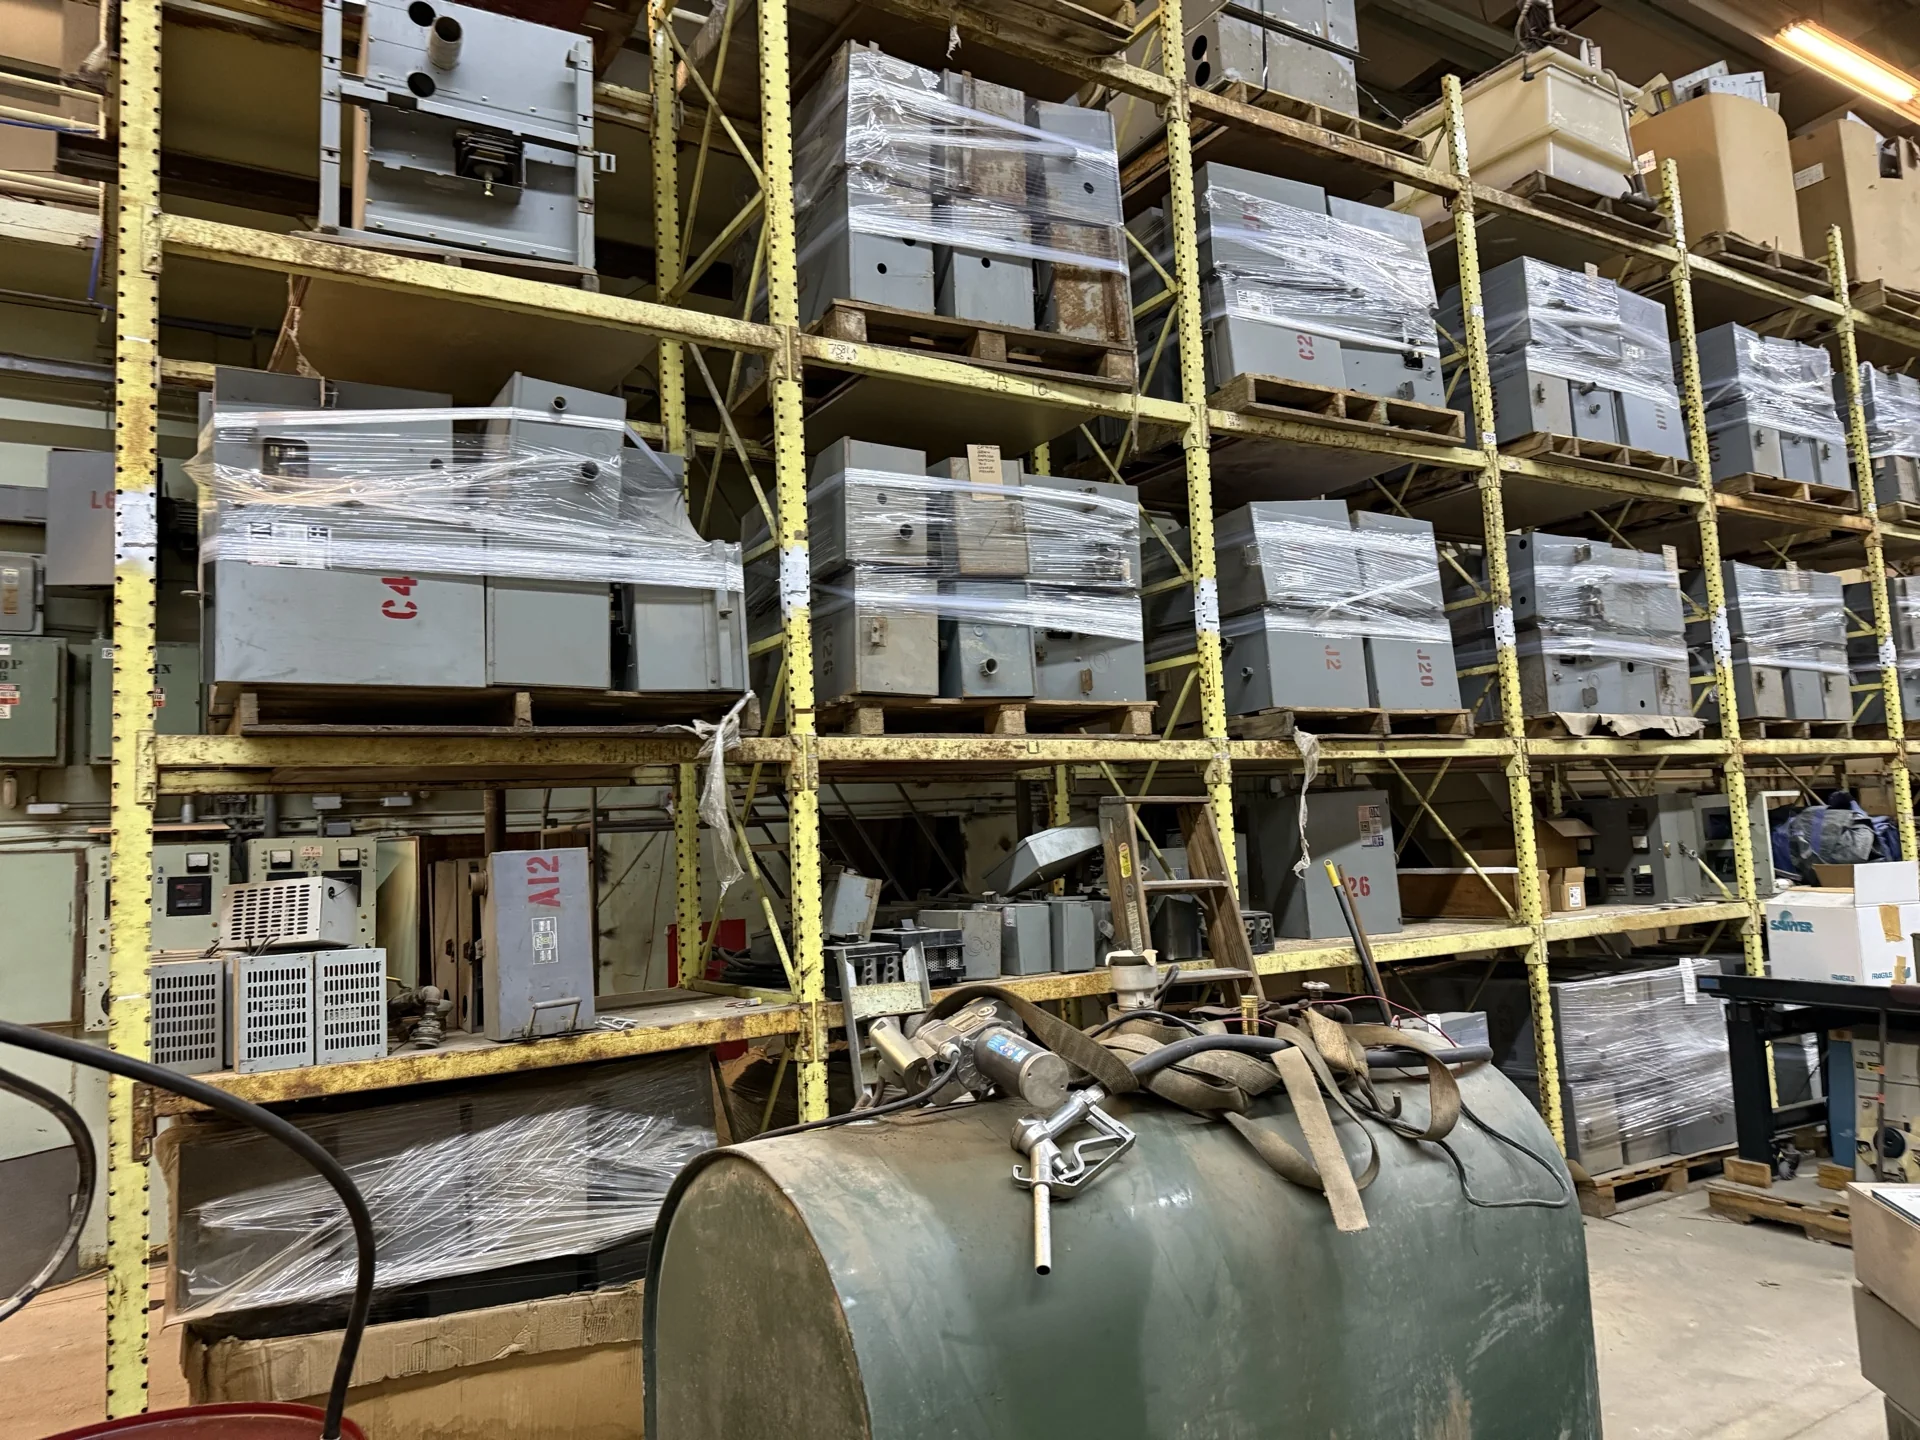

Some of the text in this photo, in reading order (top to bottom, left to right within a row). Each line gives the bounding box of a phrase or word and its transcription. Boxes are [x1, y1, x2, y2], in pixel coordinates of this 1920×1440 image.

[1297, 335, 1315, 361] C2
[381, 576, 418, 620] C4
[1325, 644, 1342, 671] J2
[1416, 648, 1435, 687] J20
[526, 855, 561, 908] A12
[1339, 875, 1371, 898] 26
[1871, 971, 1893, 980] FRAGILE
